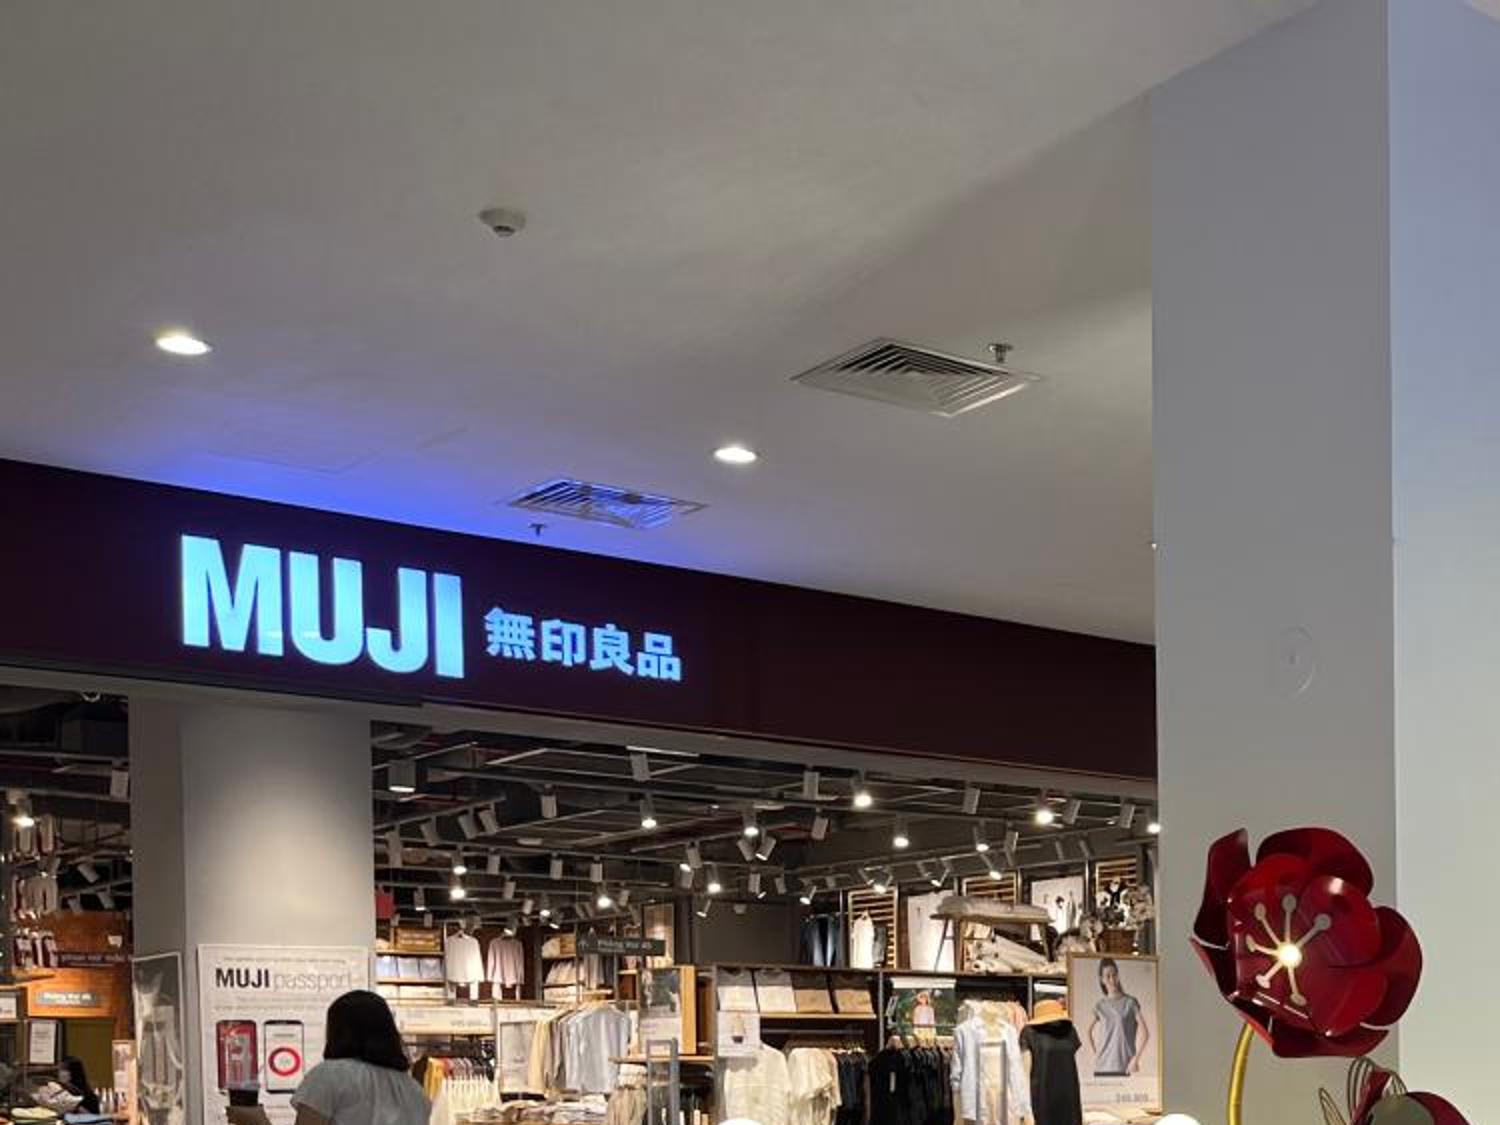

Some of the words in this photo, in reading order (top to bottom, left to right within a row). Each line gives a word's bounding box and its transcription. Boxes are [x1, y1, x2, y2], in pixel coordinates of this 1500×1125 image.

[181, 534, 464, 678] MUJI
[484, 607, 681, 681] 無印良品
[215, 968, 270, 988] MUJI
